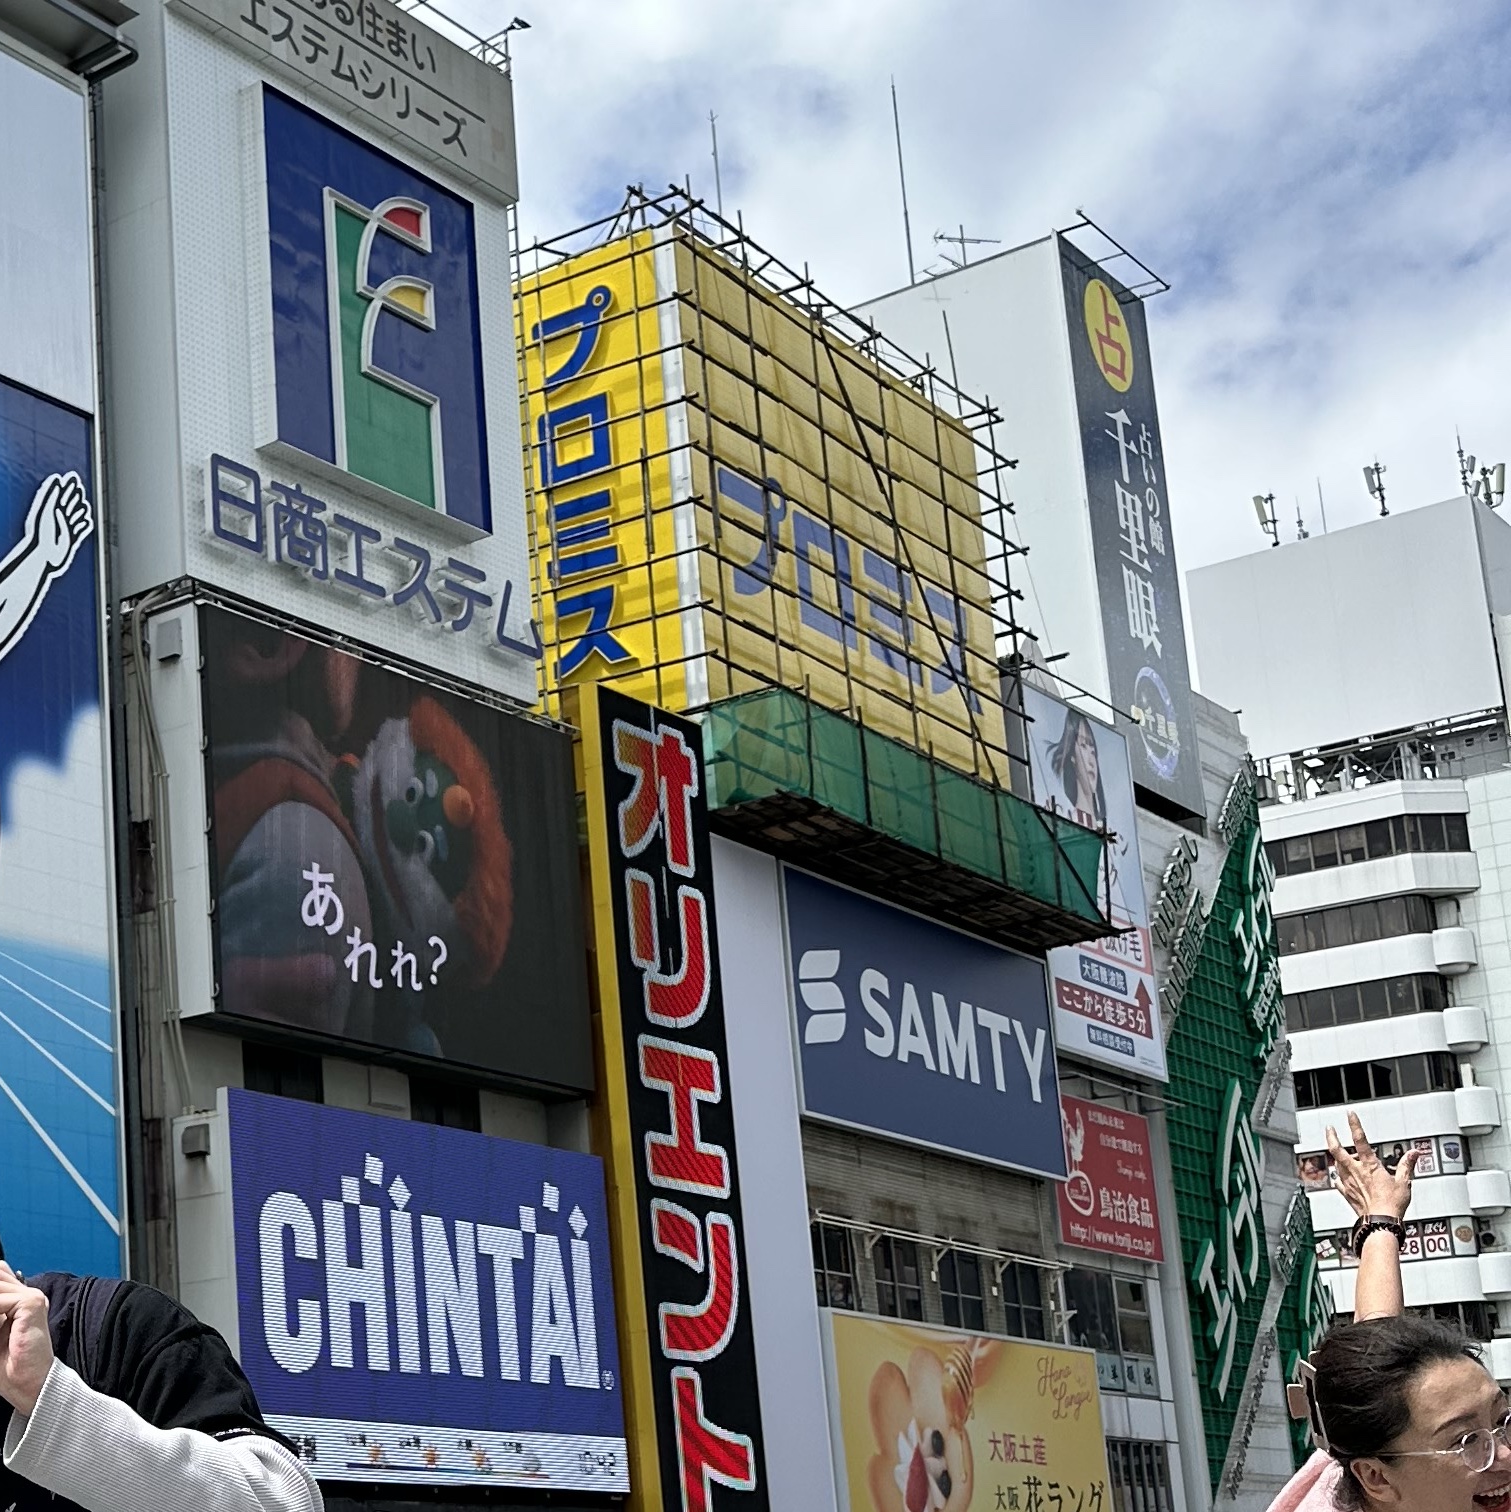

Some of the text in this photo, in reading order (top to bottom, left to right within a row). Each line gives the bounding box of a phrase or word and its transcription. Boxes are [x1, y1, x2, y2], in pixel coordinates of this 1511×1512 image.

[1094, 284, 1128, 382] 占
[210, 452, 543, 660] 日商エステム
[532, 285, 638, 681] プロミス
[1104, 408, 1162, 659] 千里眼
[1139, 422, 1166, 557] 占いの館
[717, 467, 984, 715] プロミス
[860, 968, 1046, 1103] SAMTY
[1062, 986, 1146, 1035] ここから徒歩5分
[259, 1153, 601, 1389] CHINTAI
[989, 1432, 1047, 1465] 大阪土産
